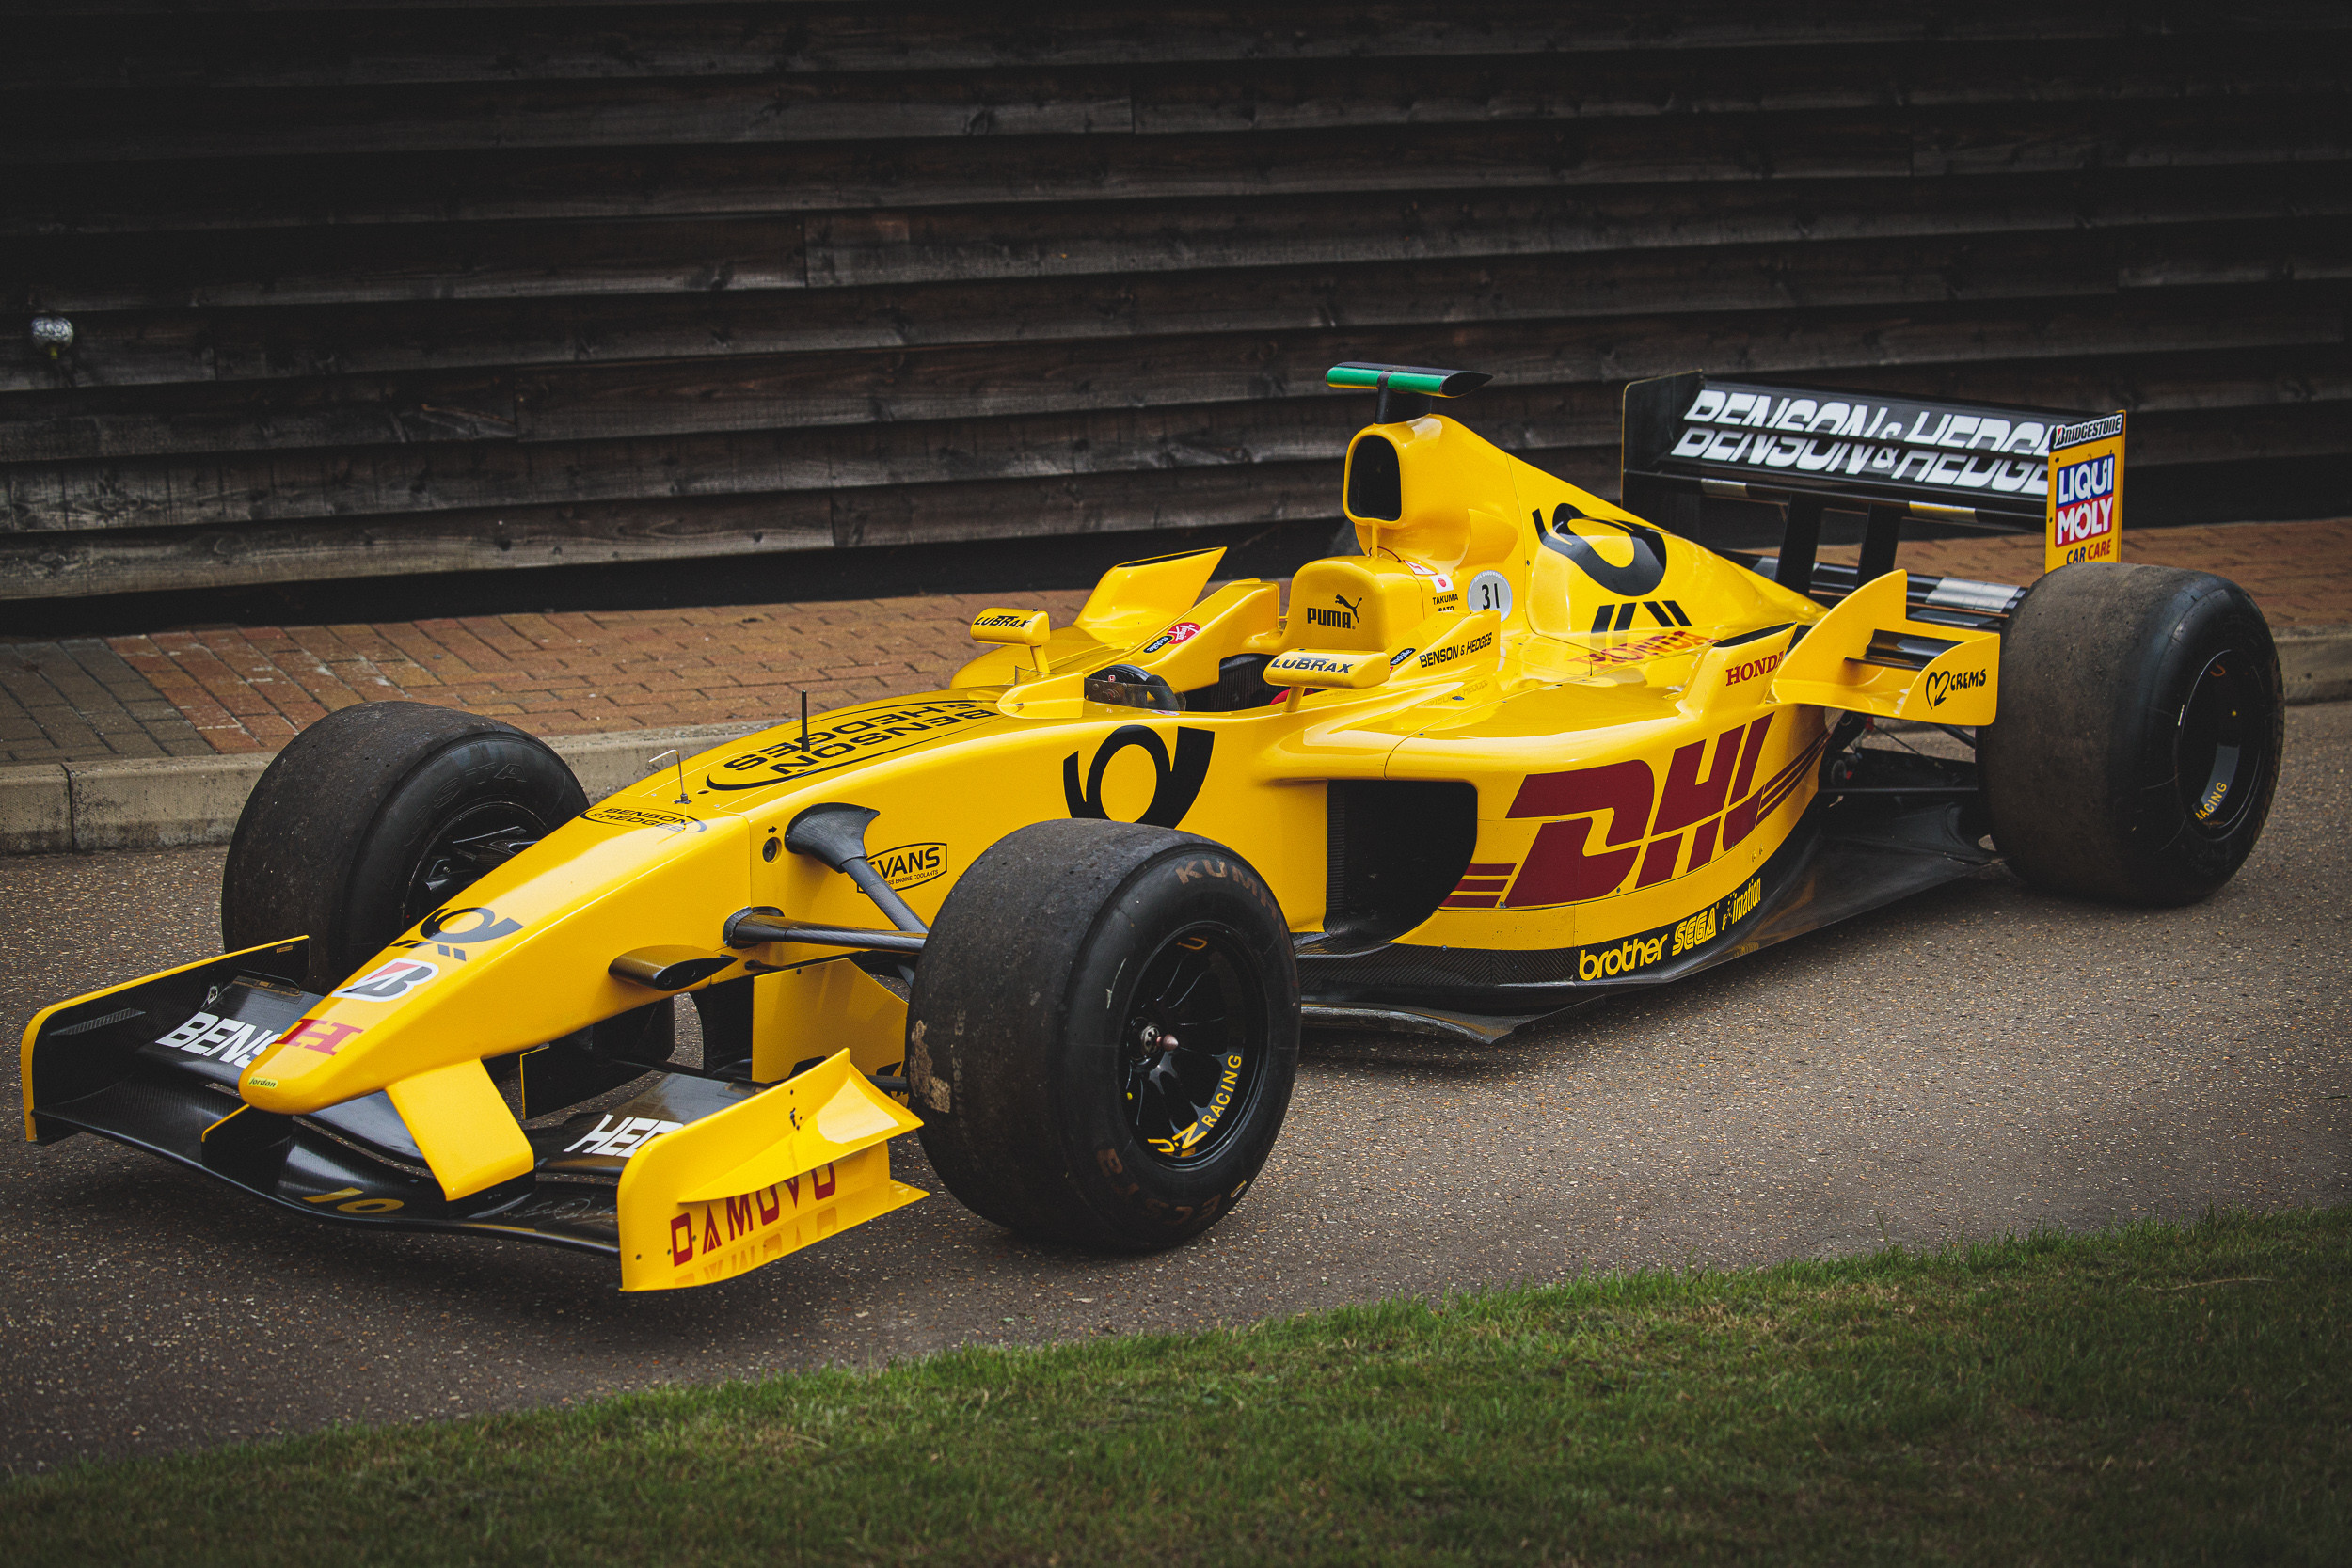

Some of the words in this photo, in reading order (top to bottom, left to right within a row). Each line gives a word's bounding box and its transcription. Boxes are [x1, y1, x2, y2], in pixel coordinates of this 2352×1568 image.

[2054, 416, 2122, 448] BRIDGESTONE
[1890, 411, 2055, 496] HEDGE
[2058, 457, 2114, 504] LIQUI
[2057, 496, 2113, 546] MOLY
[2066, 546, 2086, 564] CAR
[2088, 538, 2112, 561] CARE
[1432, 593, 1459, 606] TAKUMA
[1481, 583, 1501, 610] 31
[973, 614, 1031, 628] LUBRAX
[1307, 607, 1352, 629] PUMA
[1270, 657, 1355, 673] LUBRAX
[1418, 645, 1459, 669] BENSON
[1466, 631, 1493, 655] HEDGES
[1950, 668, 1987, 692] CREMS
[723, 705, 946, 771] HEDGES
[768, 708, 1000, 775] BENSON
[599, 813, 686, 833] HEDGES
[603, 807, 693, 826] BENSON
[1503, 711, 1776, 909] DHL
[895, 876, 913, 885] ENGINE
[913, 869, 939, 880] COOLANTS
[1732, 877, 1761, 925] imation
[1671, 906, 1717, 957] SEGA
[1579, 932, 1669, 981] brother
[154, 1011, 283, 1069] BENS
[248, 1077, 277, 1088] Jordan
[1200, 1054, 1242, 1128] RACING
[301, 1186, 405, 1213] 10
[670, 1161, 837, 1268] DAMOVO
